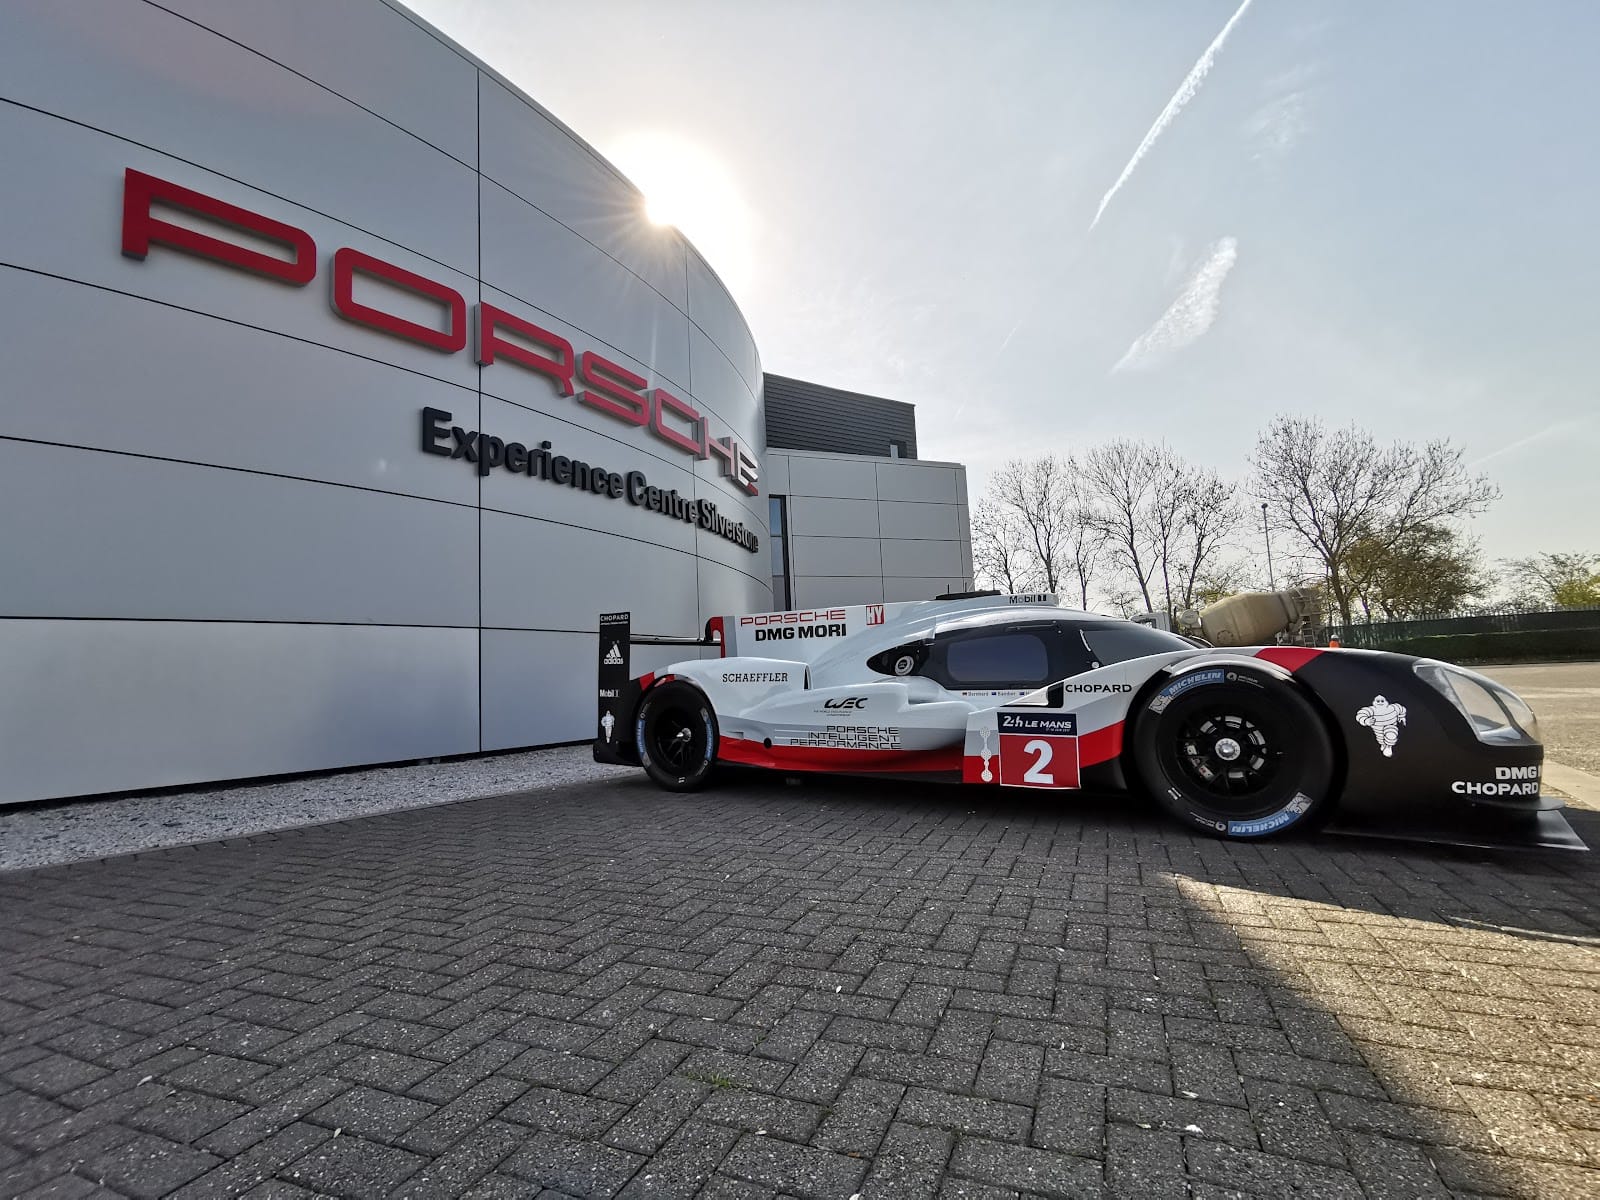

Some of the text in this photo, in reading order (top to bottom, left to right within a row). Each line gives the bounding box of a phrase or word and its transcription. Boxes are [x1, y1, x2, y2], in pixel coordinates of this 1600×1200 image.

[121, 168, 759, 496] PORSCHE
[422, 406, 759, 553] Experience Centre Silverstone
[600, 614, 629, 622] CHOPARD
[740, 609, 846, 627] PORSCHE
[755, 623, 847, 641] DMG MORI
[603, 657, 624, 665] adidas
[722, 672, 788, 683] SCHAEFFLER
[1168, 672, 1222, 695] MICHELIN
[599, 689, 615, 697] Mobil
[1065, 684, 1132, 693] CHOPARD
[823, 697, 868, 709] WEC
[826, 725, 899, 735] PORSCHE
[1024, 720, 1038, 728] LE
[1039, 720, 1072, 729] MANS
[808, 732, 899, 742] INTELLIGENT
[790, 738, 901, 750] PERFORMANCE
[1023, 739, 1054, 784] 2
[1495, 766, 1537, 780] DMG
[1451, 781, 1539, 796] CHOPARD
[1231, 813, 1290, 833] MICHELIN
